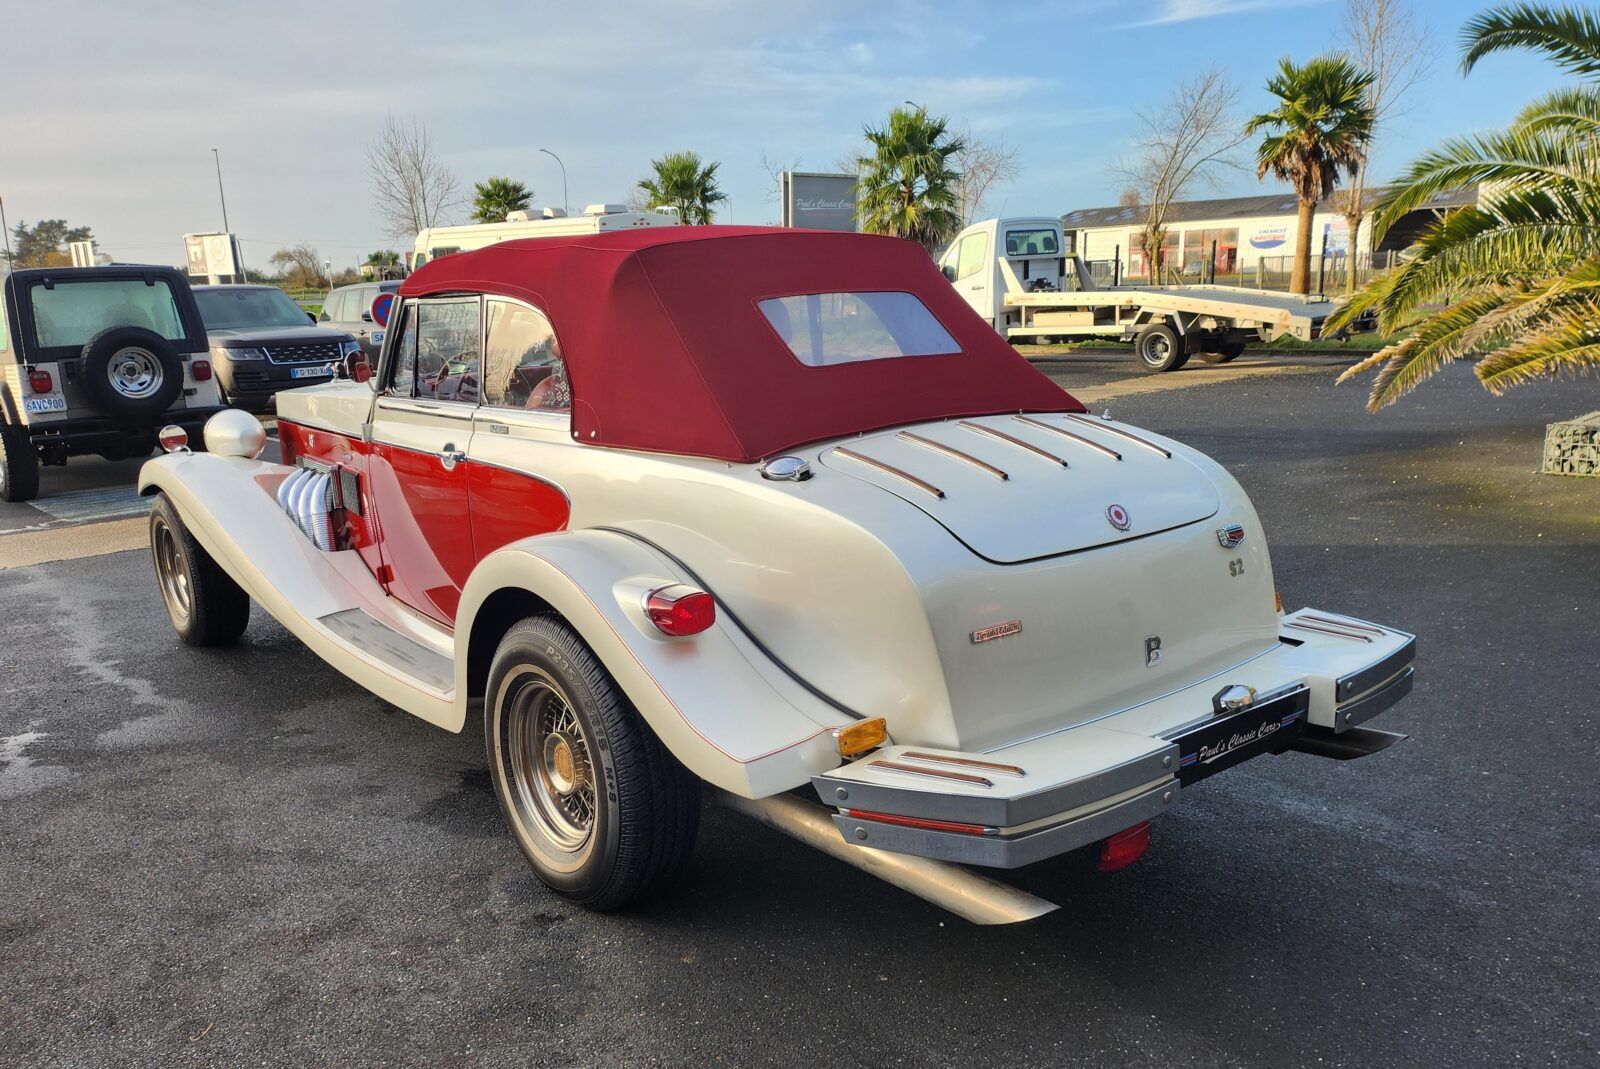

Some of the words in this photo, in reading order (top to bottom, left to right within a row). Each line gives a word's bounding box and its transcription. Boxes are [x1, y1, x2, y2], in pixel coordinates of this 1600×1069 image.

[796, 198, 816, 208] Paul's
[26, 399, 64, 411] 6AVC900
[1228, 557, 1245, 577] S2
[1199, 738, 1227, 761] Paul's
[1227, 732, 1257, 751] Classic
[1257, 721, 1280, 738] Cars
[604, 766, 617, 804] M+S
